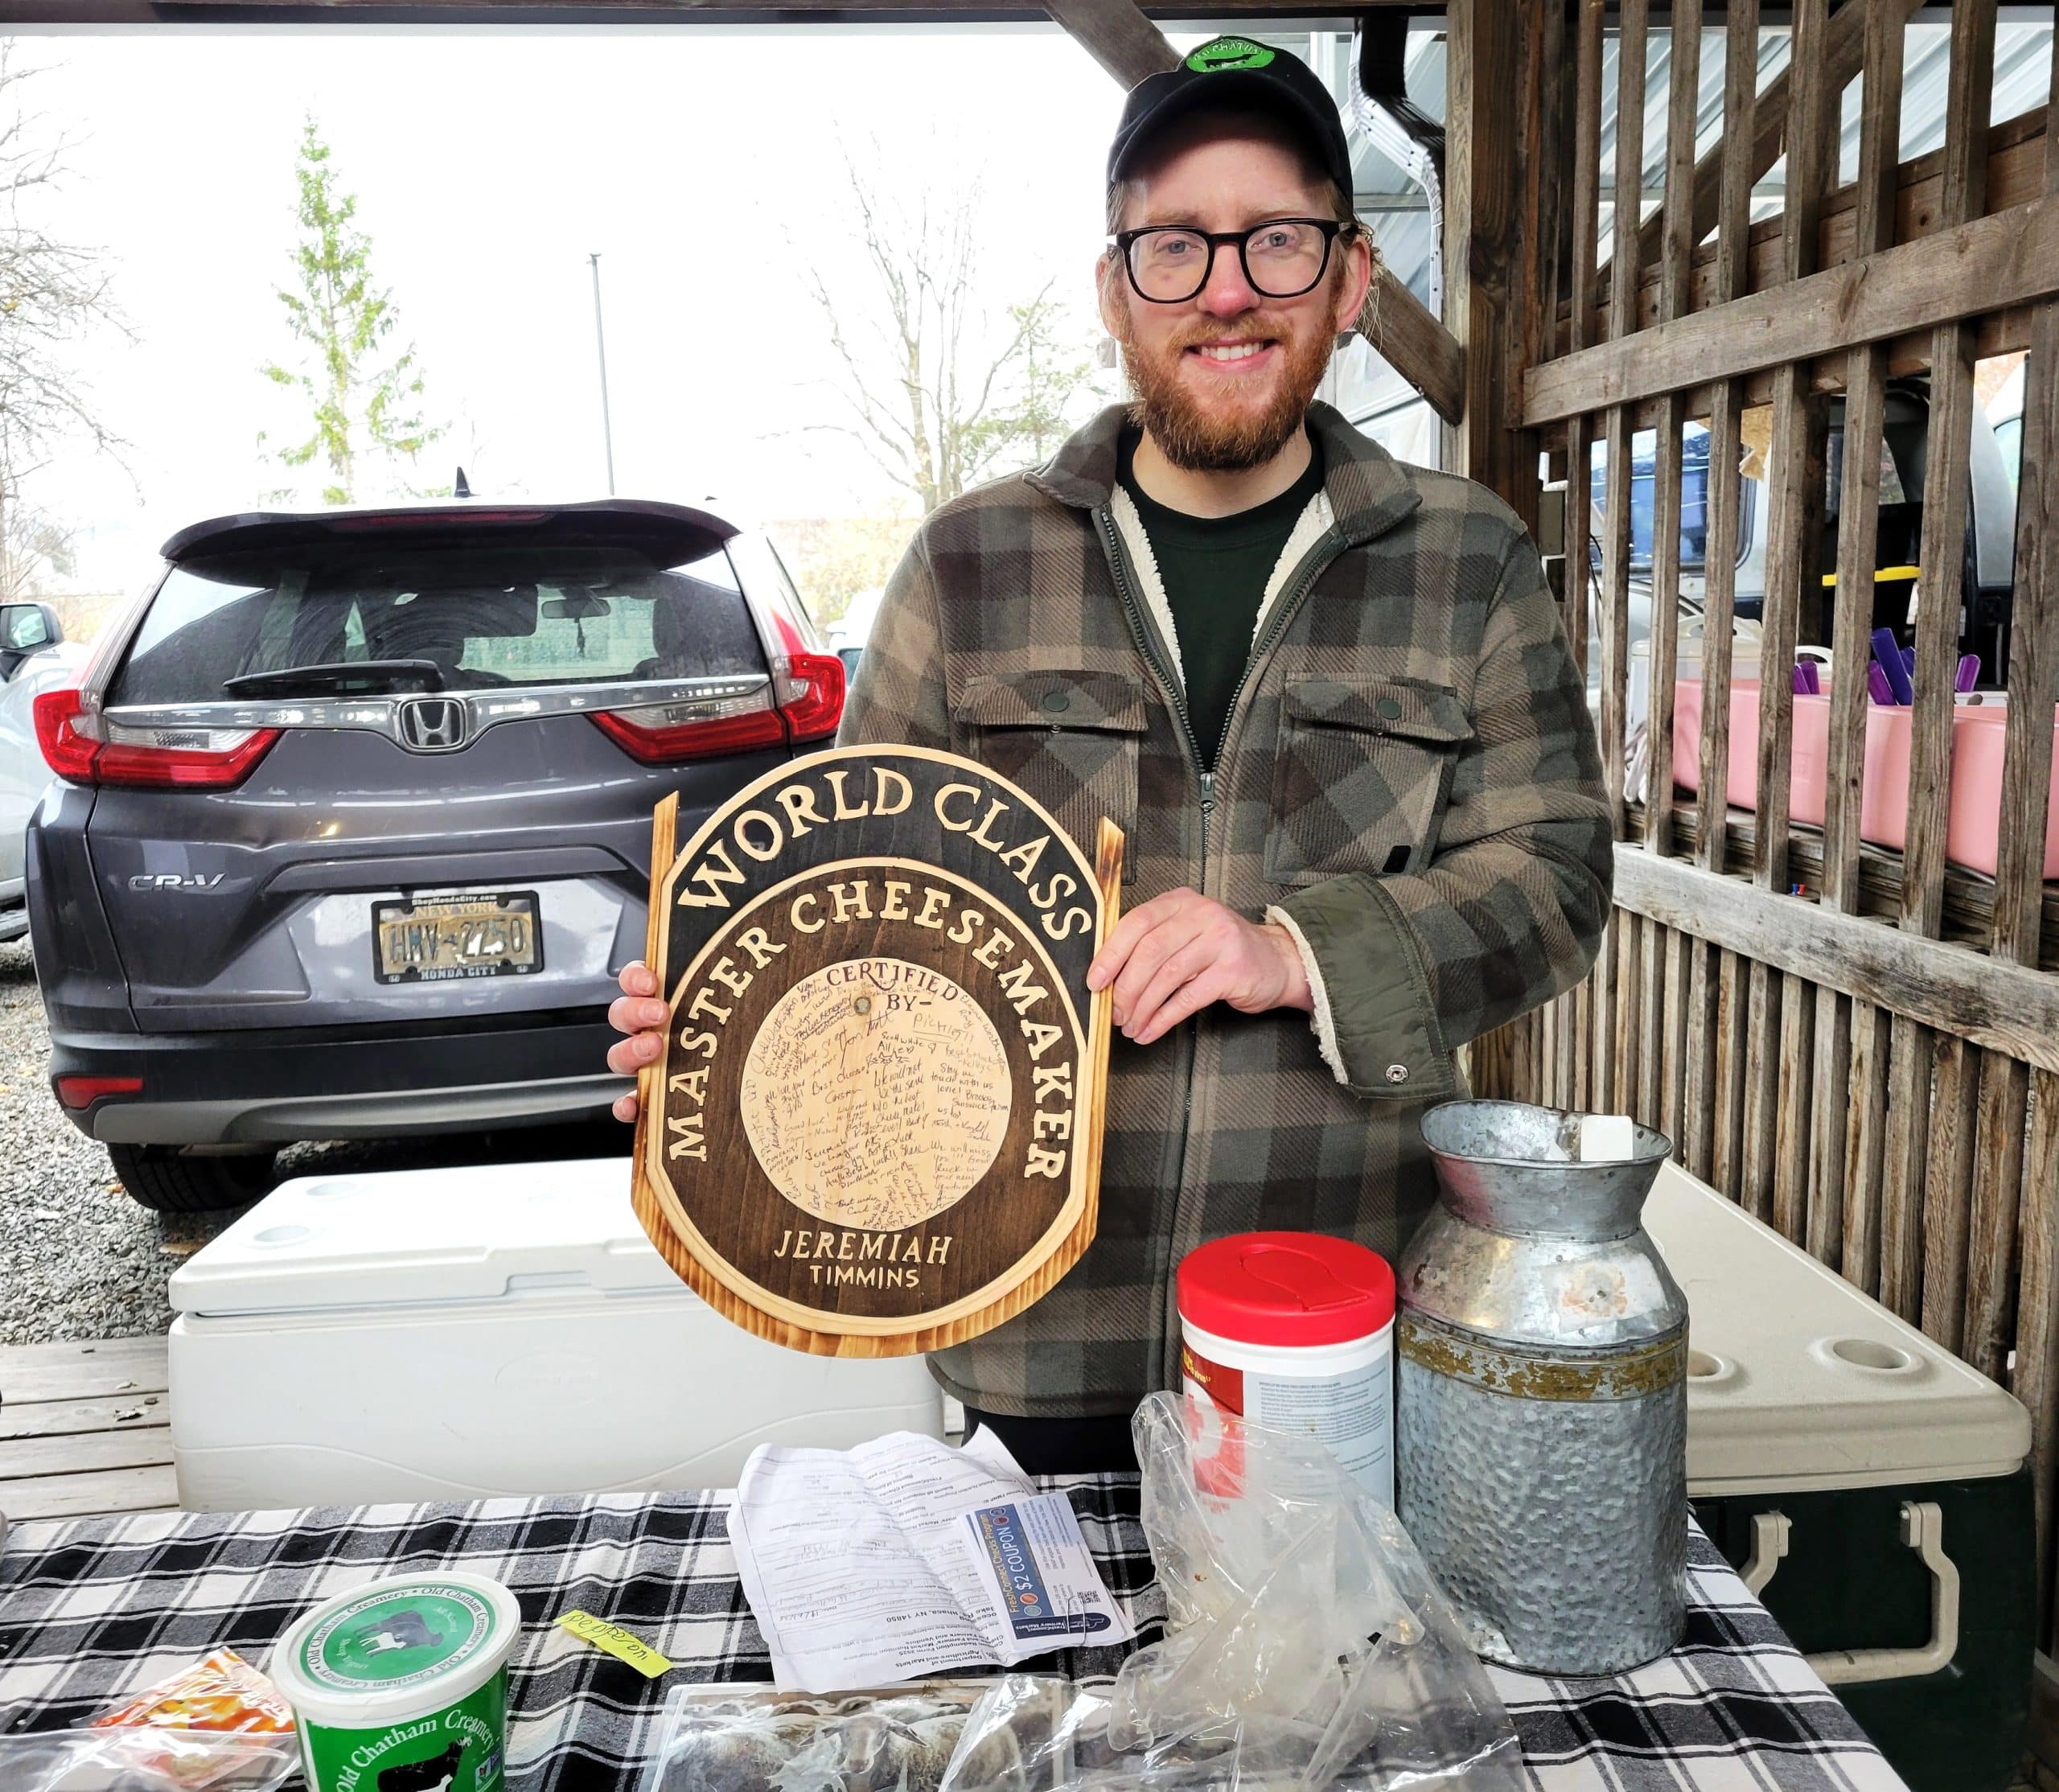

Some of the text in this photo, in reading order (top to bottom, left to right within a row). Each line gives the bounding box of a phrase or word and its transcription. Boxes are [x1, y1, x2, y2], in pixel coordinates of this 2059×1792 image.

[677, 767, 1092, 942] WORLD CLASS
[129, 873, 226, 892] CR-V
[415, 902, 499, 918] NEW YORK
[421, 964, 496, 980] HONDA CITY
[827, 961, 959, 1001] CERTIFIED
[669, 879, 1072, 1179] MASTER CHEESEMAKER
[774, 1230, 953, 1266] JEREMIAH
[810, 1264, 919, 1289] TIMMINS
[997, 1527, 1025, 1572] COUPON
[1014, 1575, 1034, 1590] $2
[309, 1590, 408, 1665] Old Chatham Creamery
[421, 1587, 445, 1596] Old
[446, 1589, 481, 1613] Chatham
[468, 1612, 489, 1649] Creamery
[336, 1709, 495, 1792] Old Chatham Creamery
